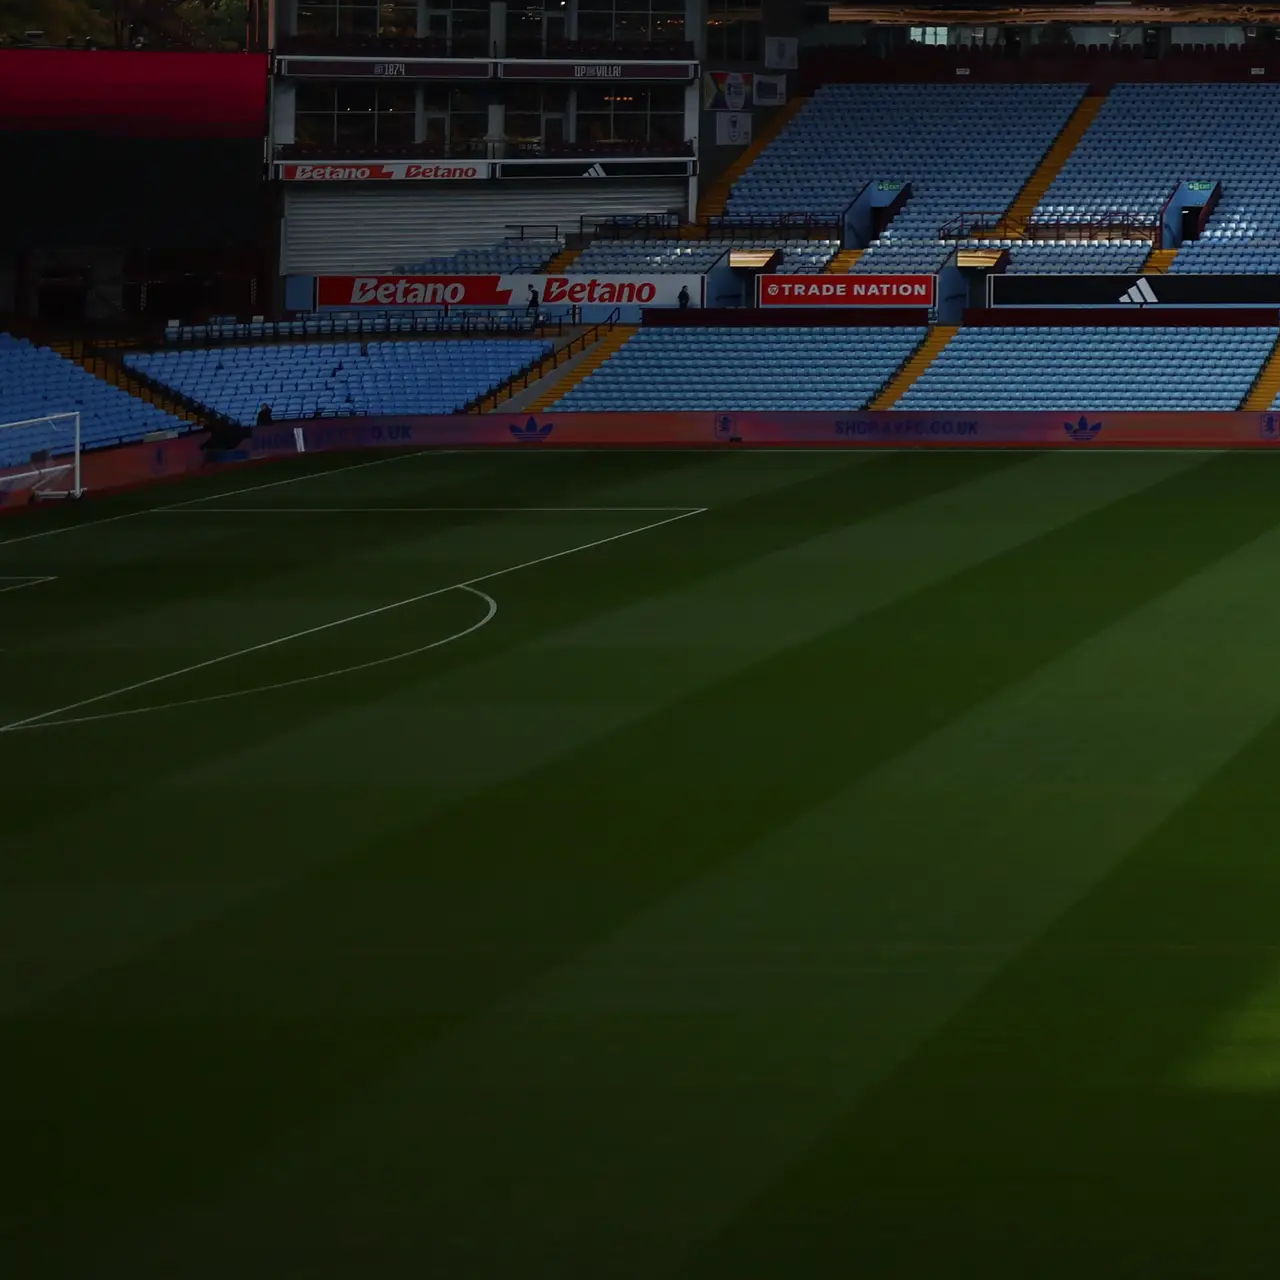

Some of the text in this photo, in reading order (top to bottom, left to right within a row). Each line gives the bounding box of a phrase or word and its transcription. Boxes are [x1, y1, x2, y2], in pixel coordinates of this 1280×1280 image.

[384, 63, 405, 75] 1874
[573, 65, 586, 77] UP
[295, 165, 476, 179] Betano Betano
[350, 277, 657, 304] Betano Betano
[782, 284, 926, 296] TRADE NATION
